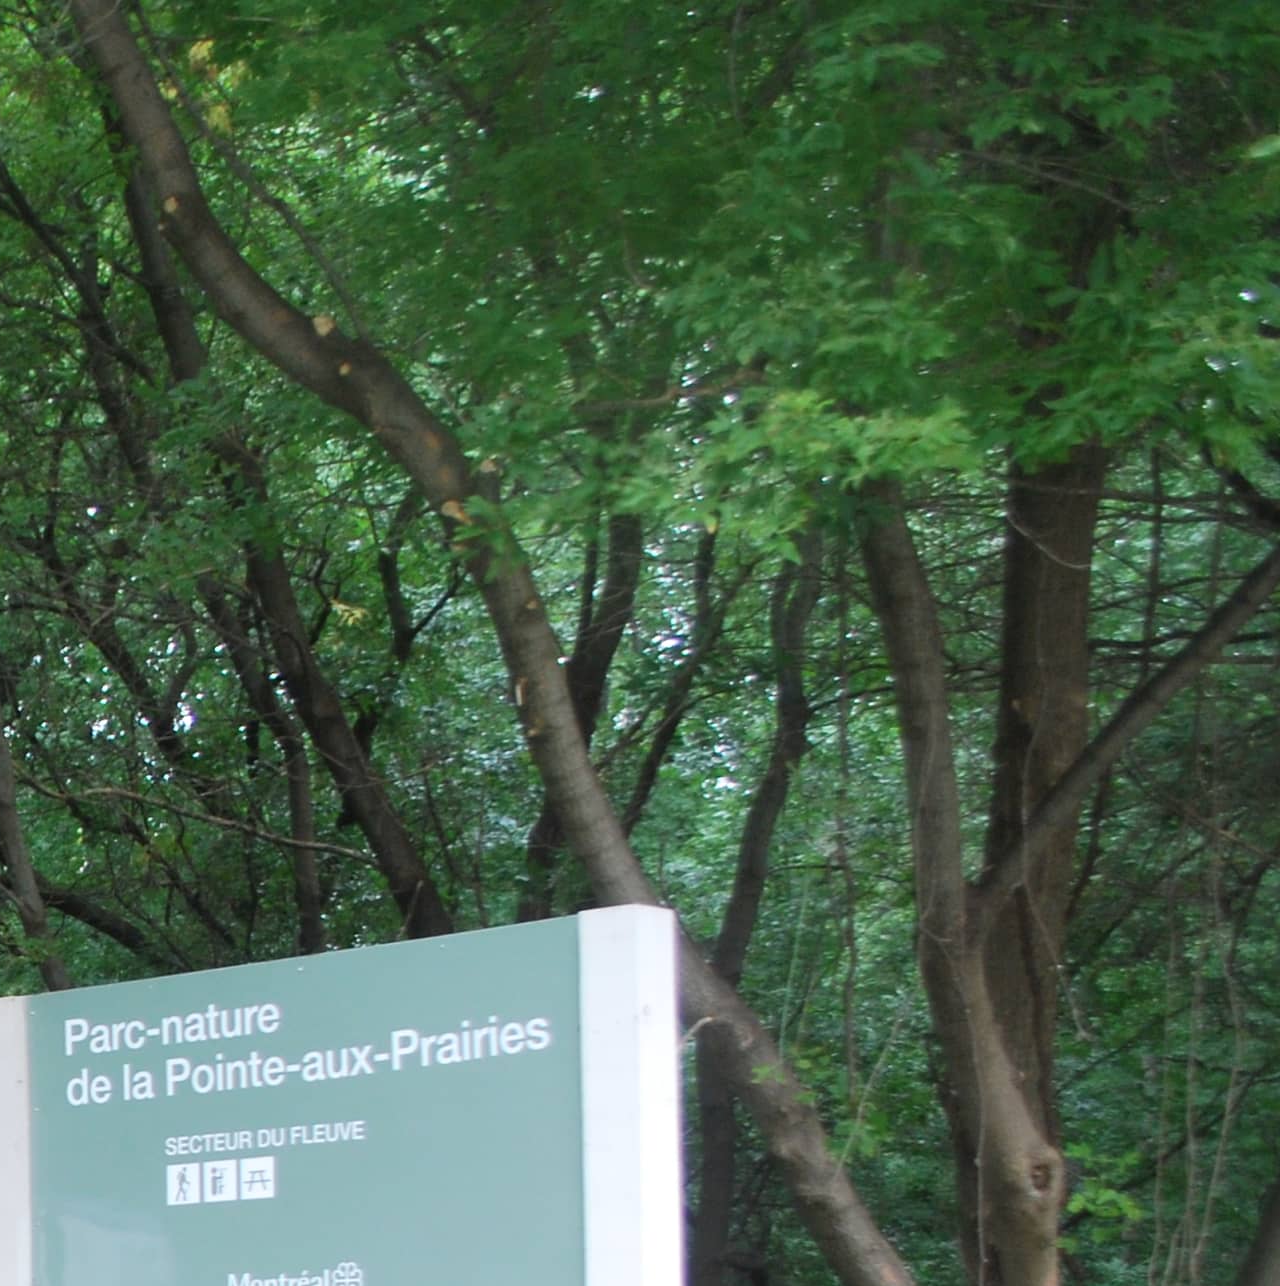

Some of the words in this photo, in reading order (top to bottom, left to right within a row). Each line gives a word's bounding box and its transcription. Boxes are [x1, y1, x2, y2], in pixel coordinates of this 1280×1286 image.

[64, 1003, 280, 1056] Parc-nature
[66, 1068, 112, 1106] de
[123, 1063, 155, 1101] la
[165, 1015, 551, 1097] Pointe-aux-Prairies
[165, 1131, 252, 1156] SECTEUR
[258, 1127, 285, 1147] DU
[290, 1120, 367, 1144] FLEUVE
